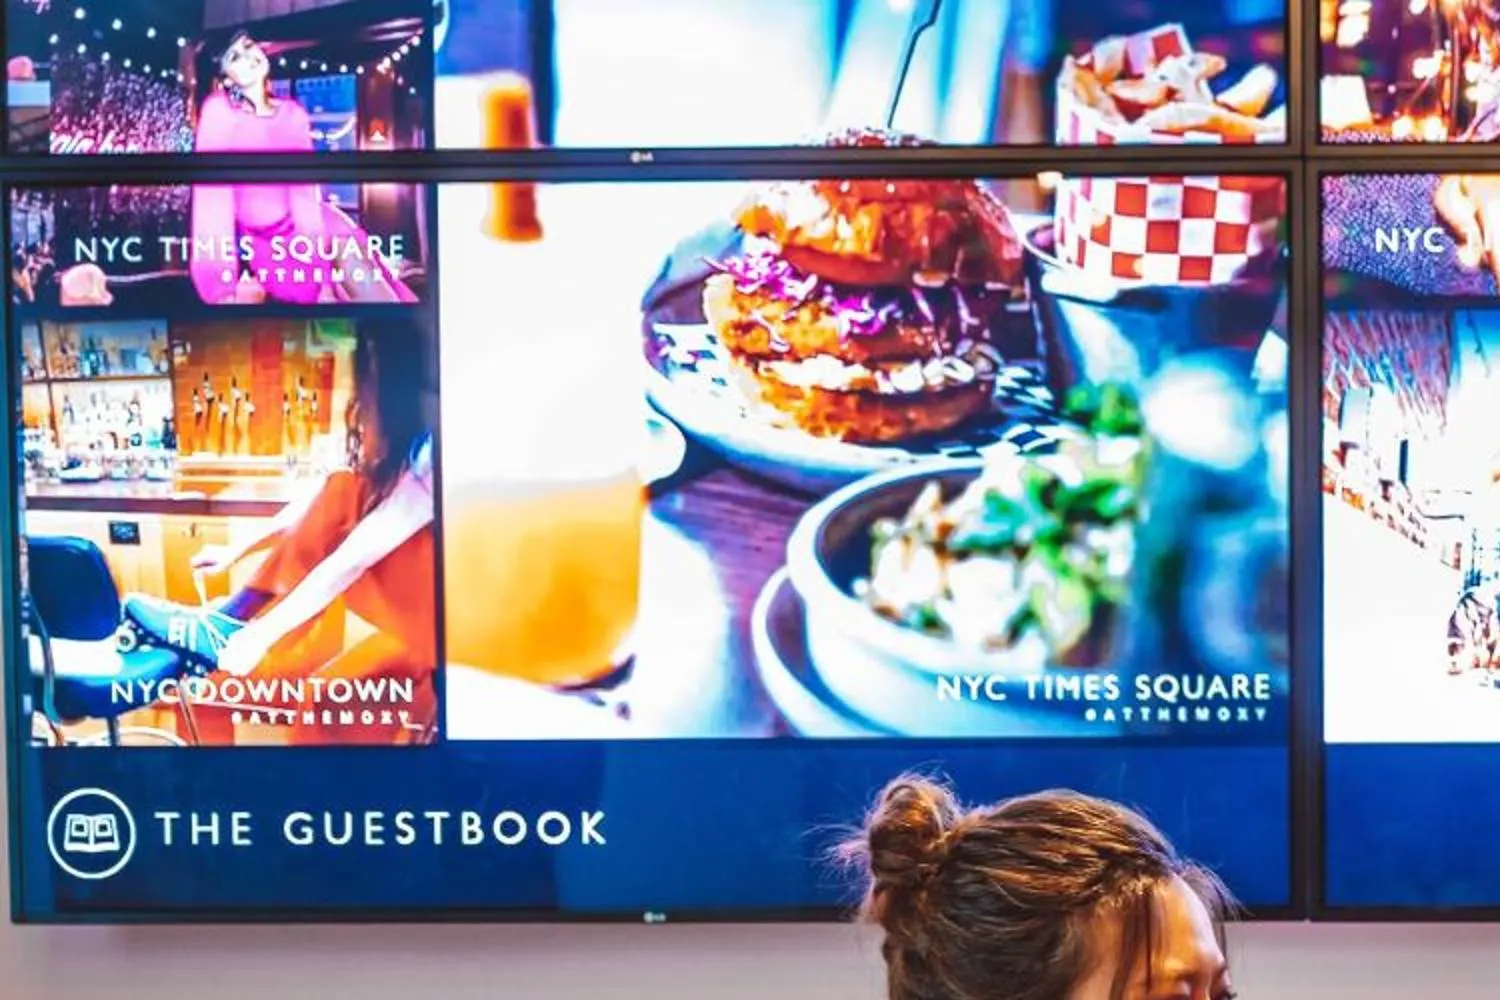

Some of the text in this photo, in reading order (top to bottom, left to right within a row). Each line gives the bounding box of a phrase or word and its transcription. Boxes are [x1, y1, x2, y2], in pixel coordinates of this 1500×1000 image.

[75, 234, 404, 263] NYC TIMES SQUARE
[1375, 226, 1445, 253] NYC
[111, 676, 413, 704] NYC DOWNTOWN
[936, 673, 1271, 703] NYC TIMES SQUARE
[154, 811, 608, 846] THE GUESTBOOK
